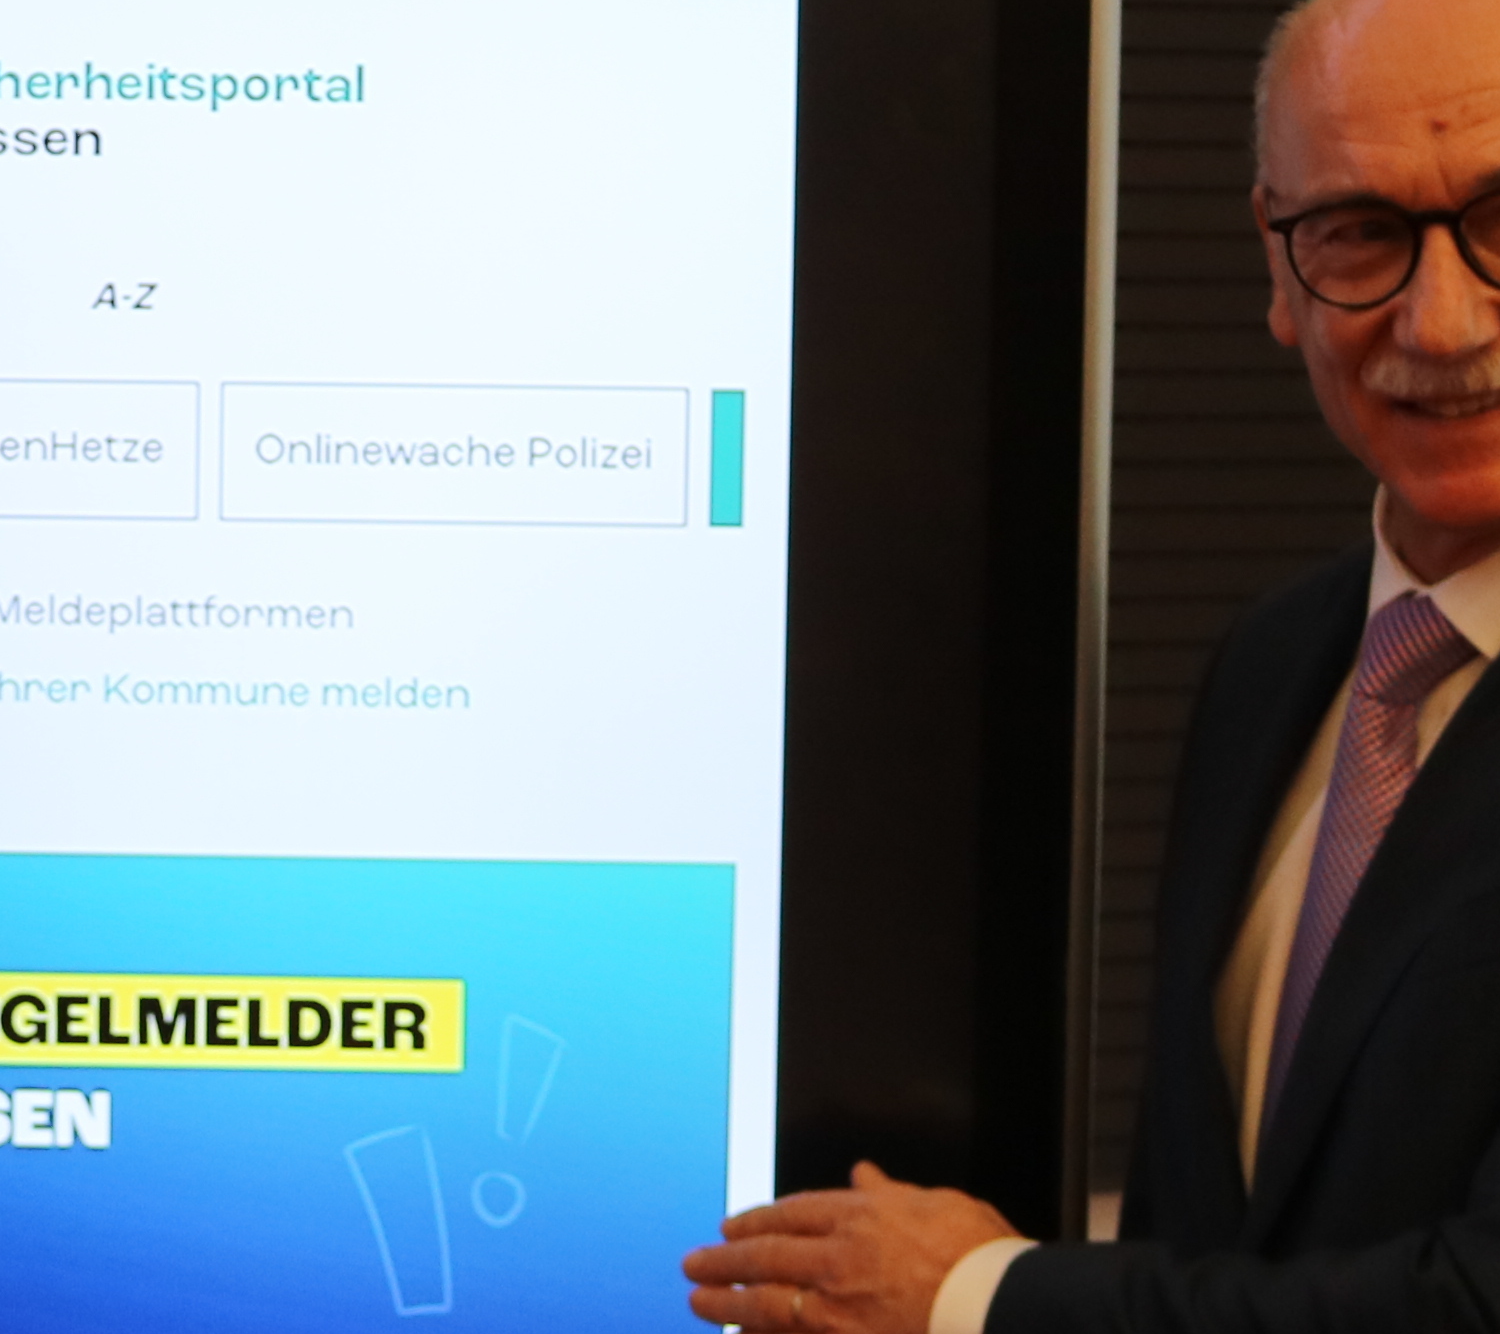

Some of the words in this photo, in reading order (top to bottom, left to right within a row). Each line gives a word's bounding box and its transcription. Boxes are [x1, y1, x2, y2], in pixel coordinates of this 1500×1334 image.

[90, 280, 159, 312] A-Z
[253, 431, 516, 470] Onlinewache
[526, 434, 654, 471] Polizei
[101, 671, 312, 709] Kommune
[320, 675, 472, 711] melden
